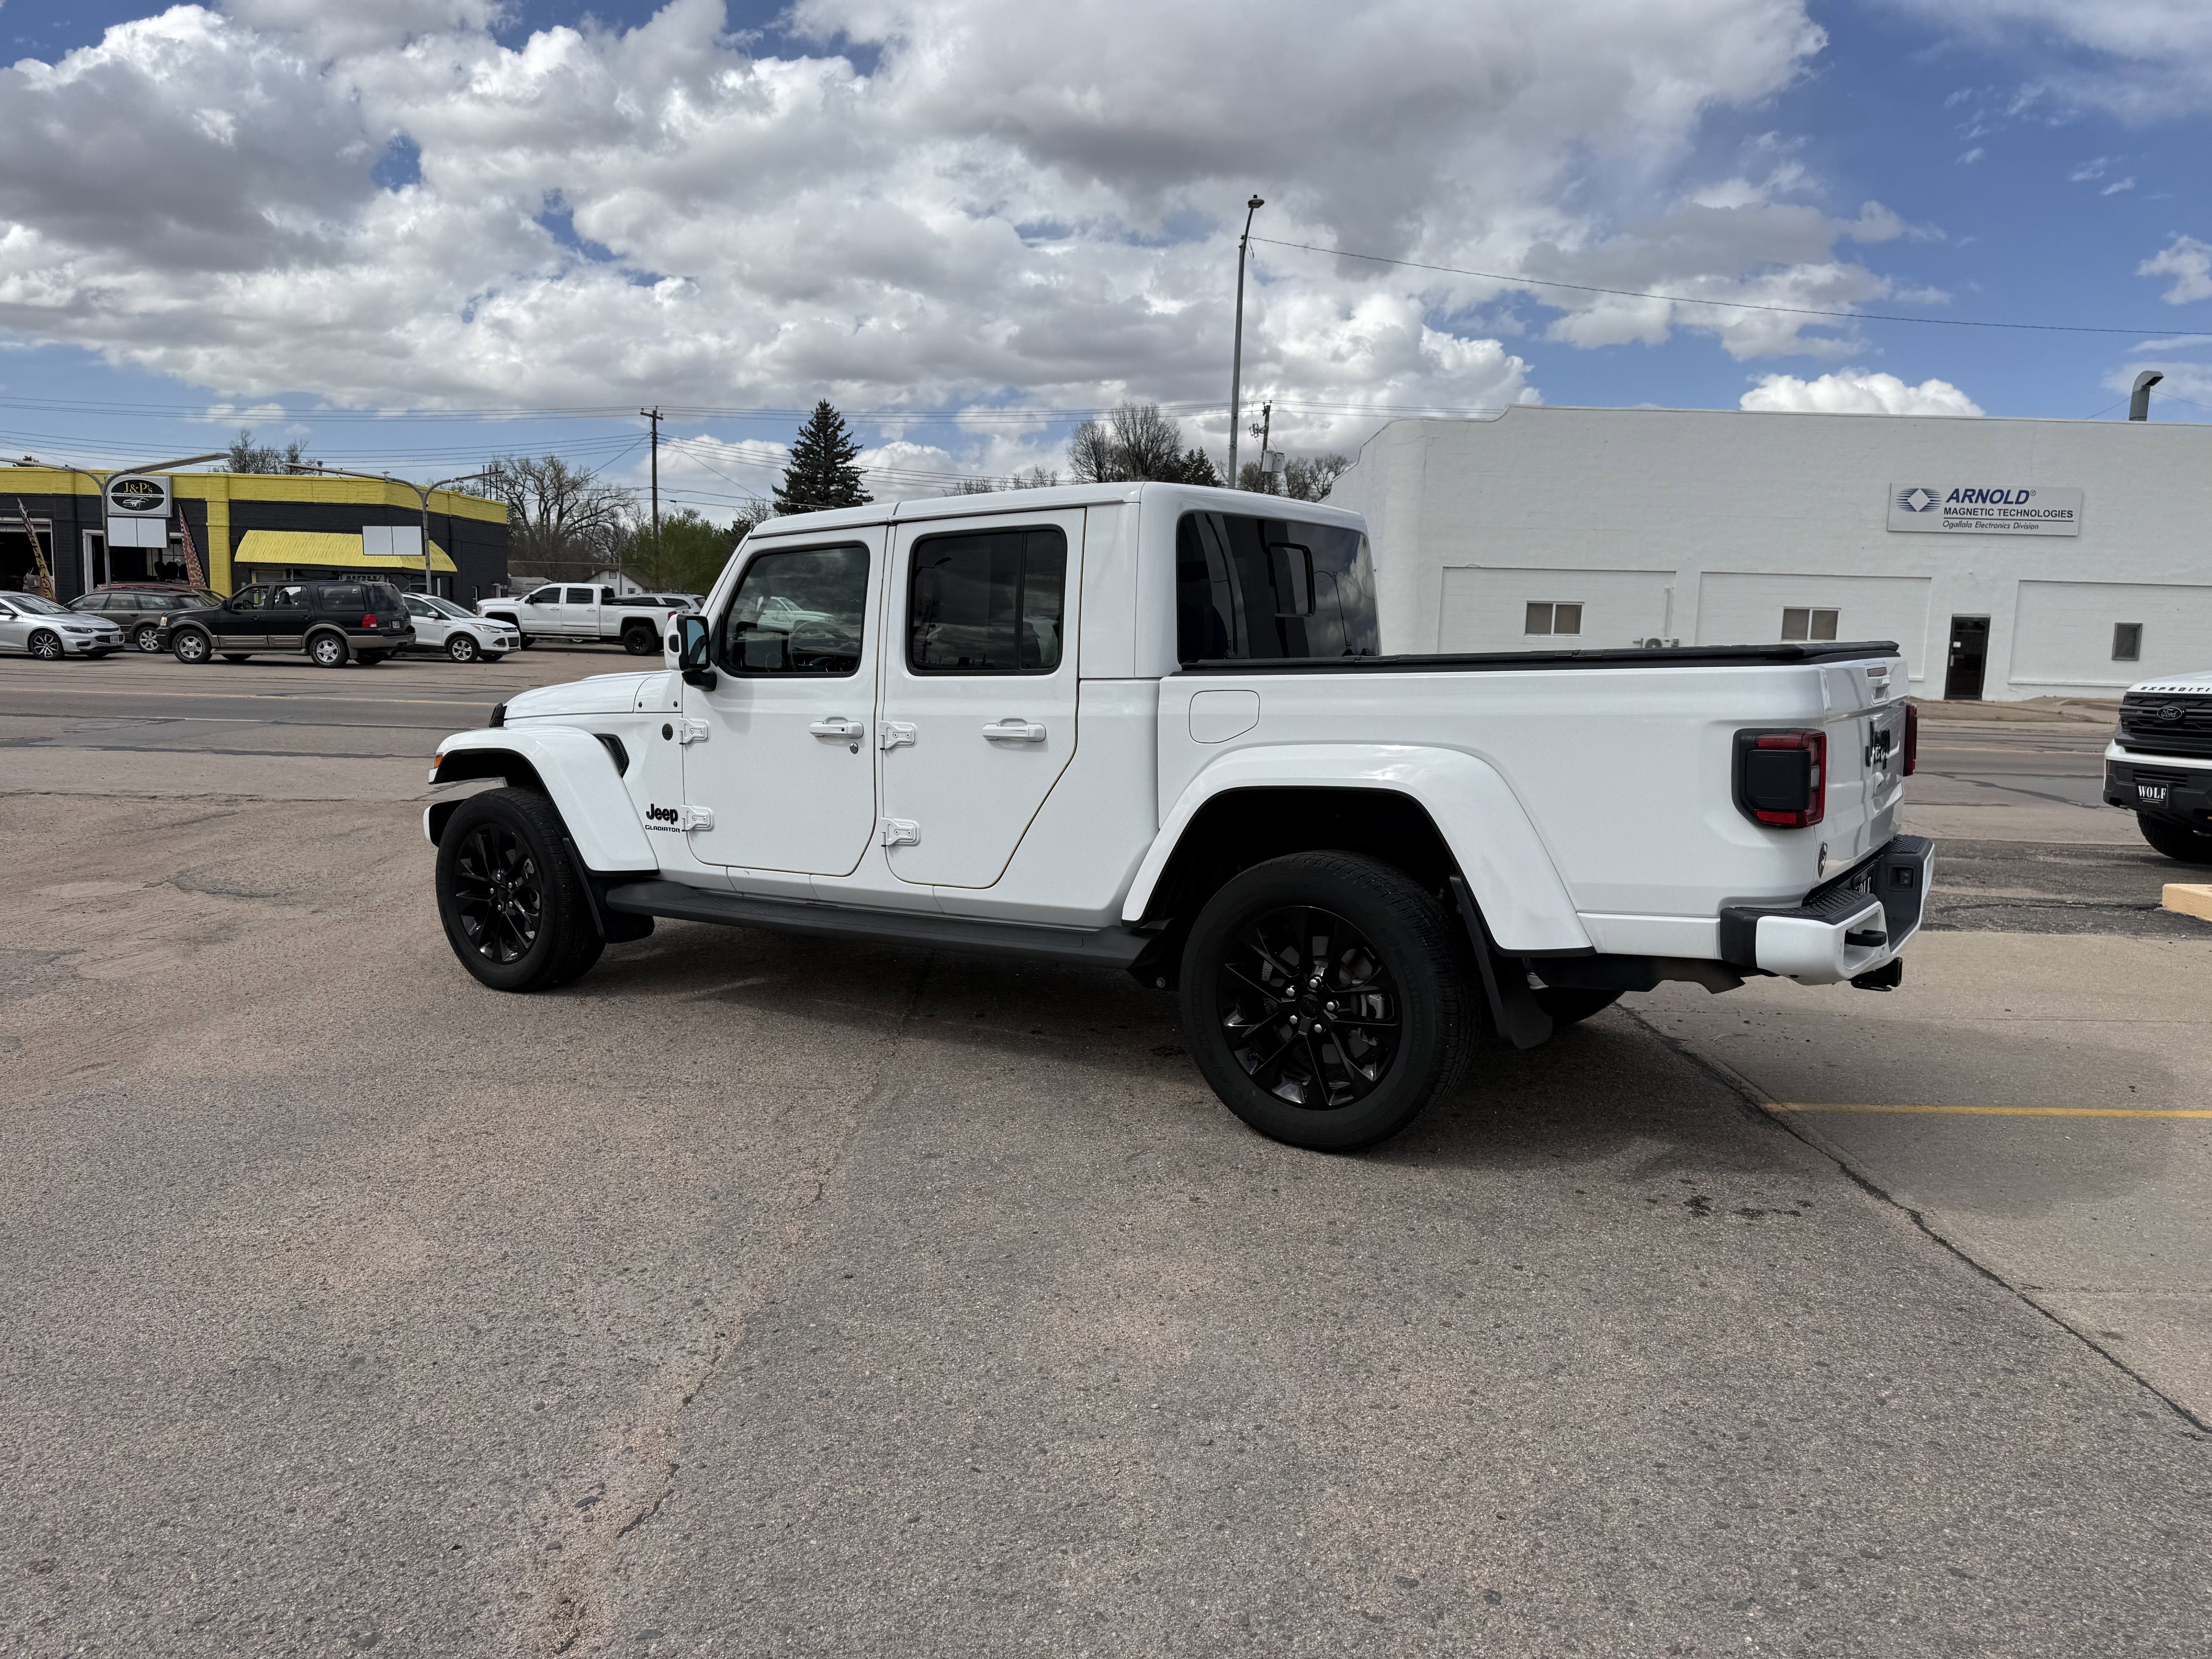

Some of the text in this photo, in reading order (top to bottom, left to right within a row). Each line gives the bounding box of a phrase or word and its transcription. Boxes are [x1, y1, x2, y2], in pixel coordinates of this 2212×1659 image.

[124, 482, 153, 494] J&P's
[1944, 507, 2073, 518] MAGNETIC TECHNOLOGIES
[1942, 520, 2039, 530] Ogallala Electronics Division
[2161, 708, 2178, 718] Ford
[2138, 785, 2167, 800] WOLF
[646, 803, 678, 825] Jeep
[645, 824, 680, 833] GLADIATOR
